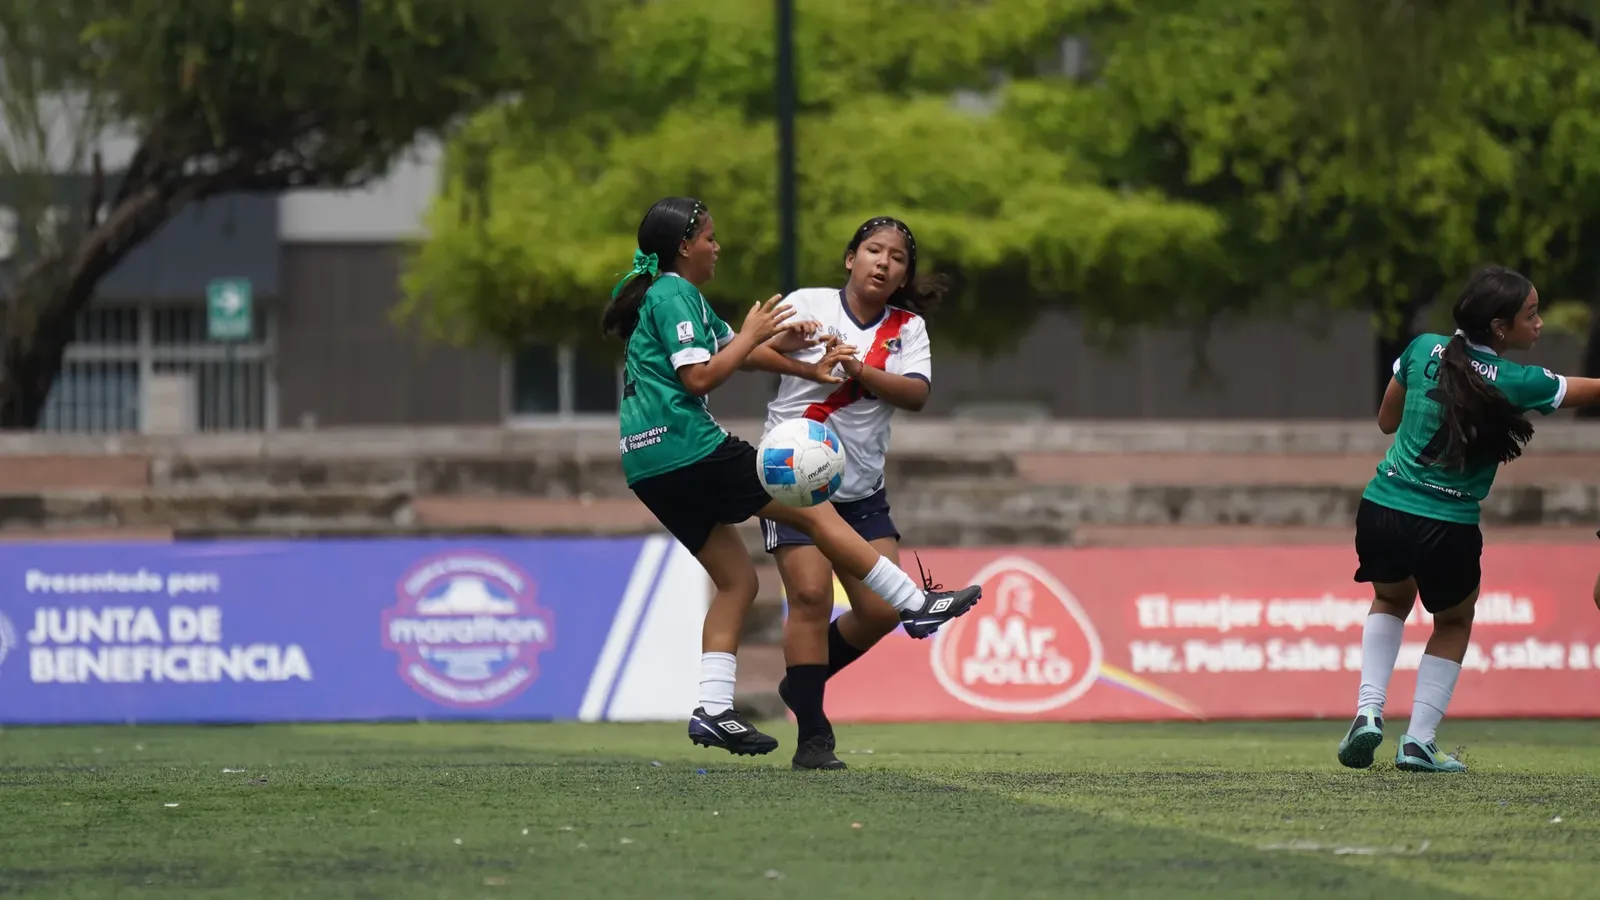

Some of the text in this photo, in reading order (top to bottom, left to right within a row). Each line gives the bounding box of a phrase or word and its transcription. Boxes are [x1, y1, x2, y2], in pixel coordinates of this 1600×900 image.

[629, 426, 667, 442] Cooperativa
[630, 436, 661, 450] Financiera
[808, 461, 830, 479] molten
[26, 568, 163, 592] Presentado
[27, 606, 222, 643] JUNTA DE
[1136, 593, 1168, 627] El
[1173, 593, 1262, 632] mejor
[390, 616, 547, 644] marathon
[30, 645, 312, 682] BENEFICENCIA
[1130, 639, 1182, 673] Mr.
[1184, 638, 1264, 673] Pollo
[1267, 637, 1340, 671] Sabe
[1491, 636, 1564, 669] sabe
[1568, 642, 1590, 669] a
[963, 658, 1073, 685] POLLO
